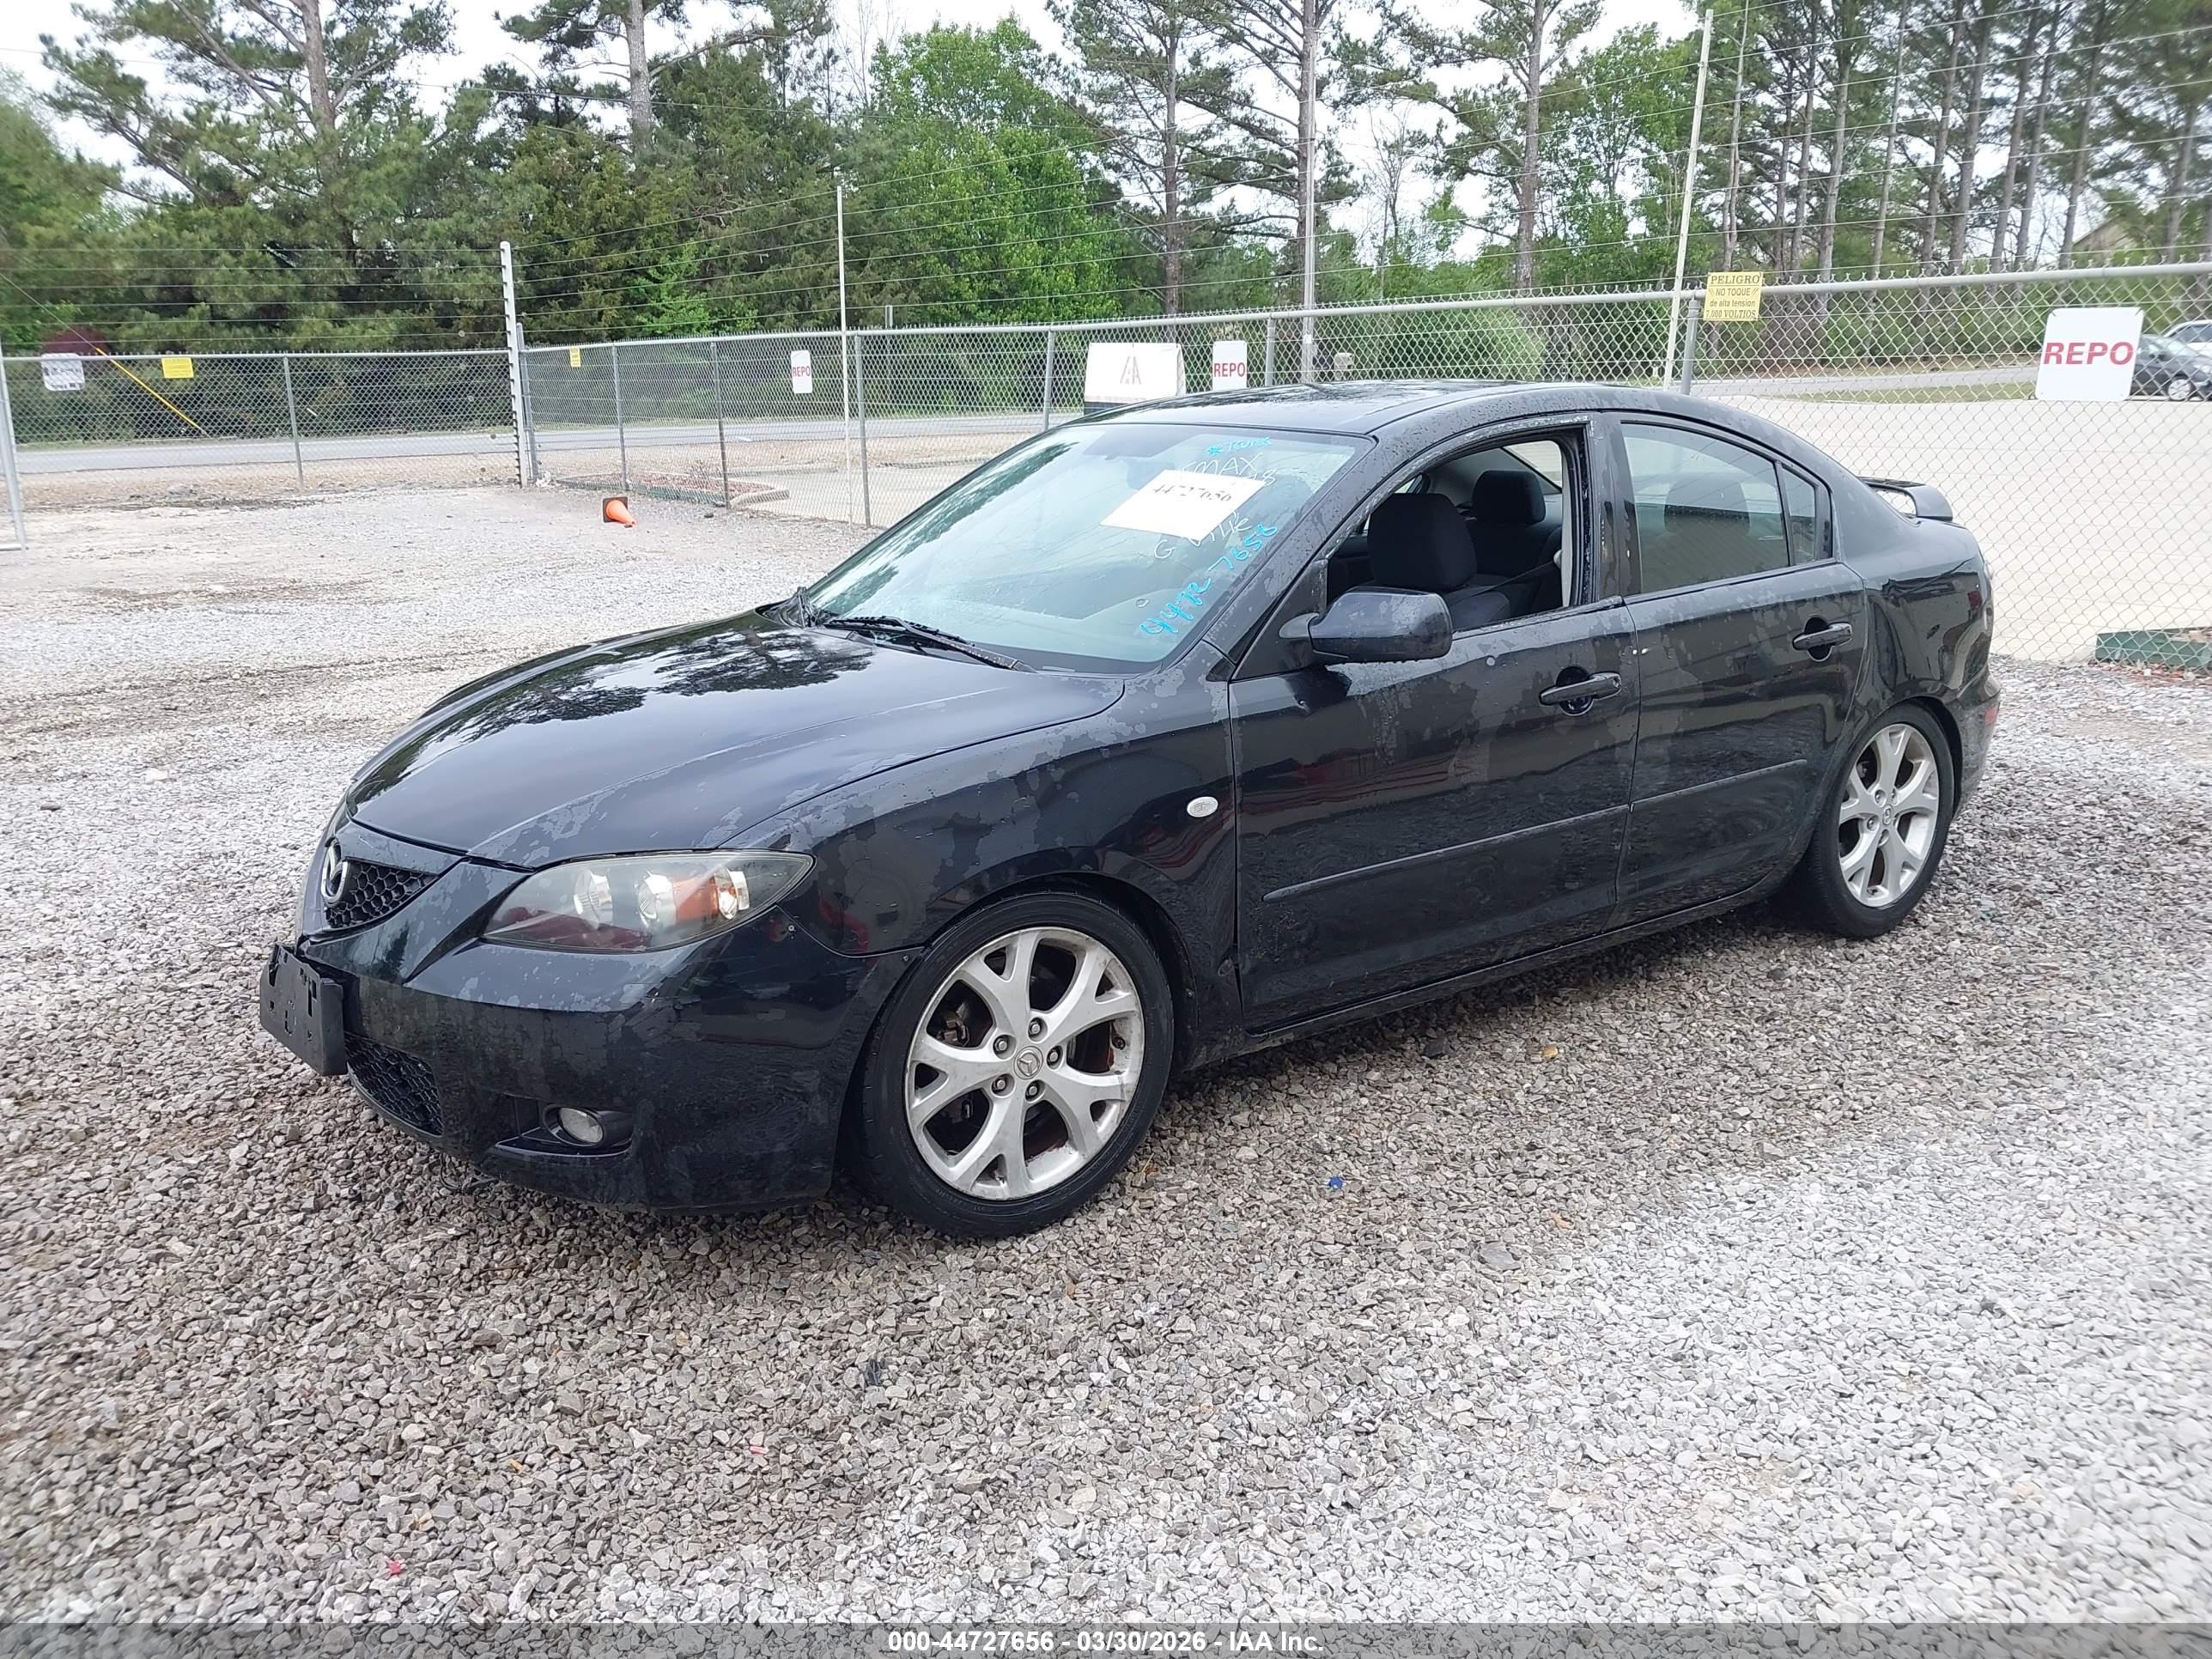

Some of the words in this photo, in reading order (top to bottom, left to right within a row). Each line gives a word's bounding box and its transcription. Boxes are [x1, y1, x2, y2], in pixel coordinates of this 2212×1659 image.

[1711, 275, 1760, 284] PELIGRO
[1716, 288, 1725, 296] NO
[1727, 288, 1751, 296] TOQUE
[1723, 309, 1757, 319] VOLTIOS
[2043, 341, 2134, 365] REPO
[792, 365, 811, 377] REPO
[1214, 362, 1246, 377] REPO
